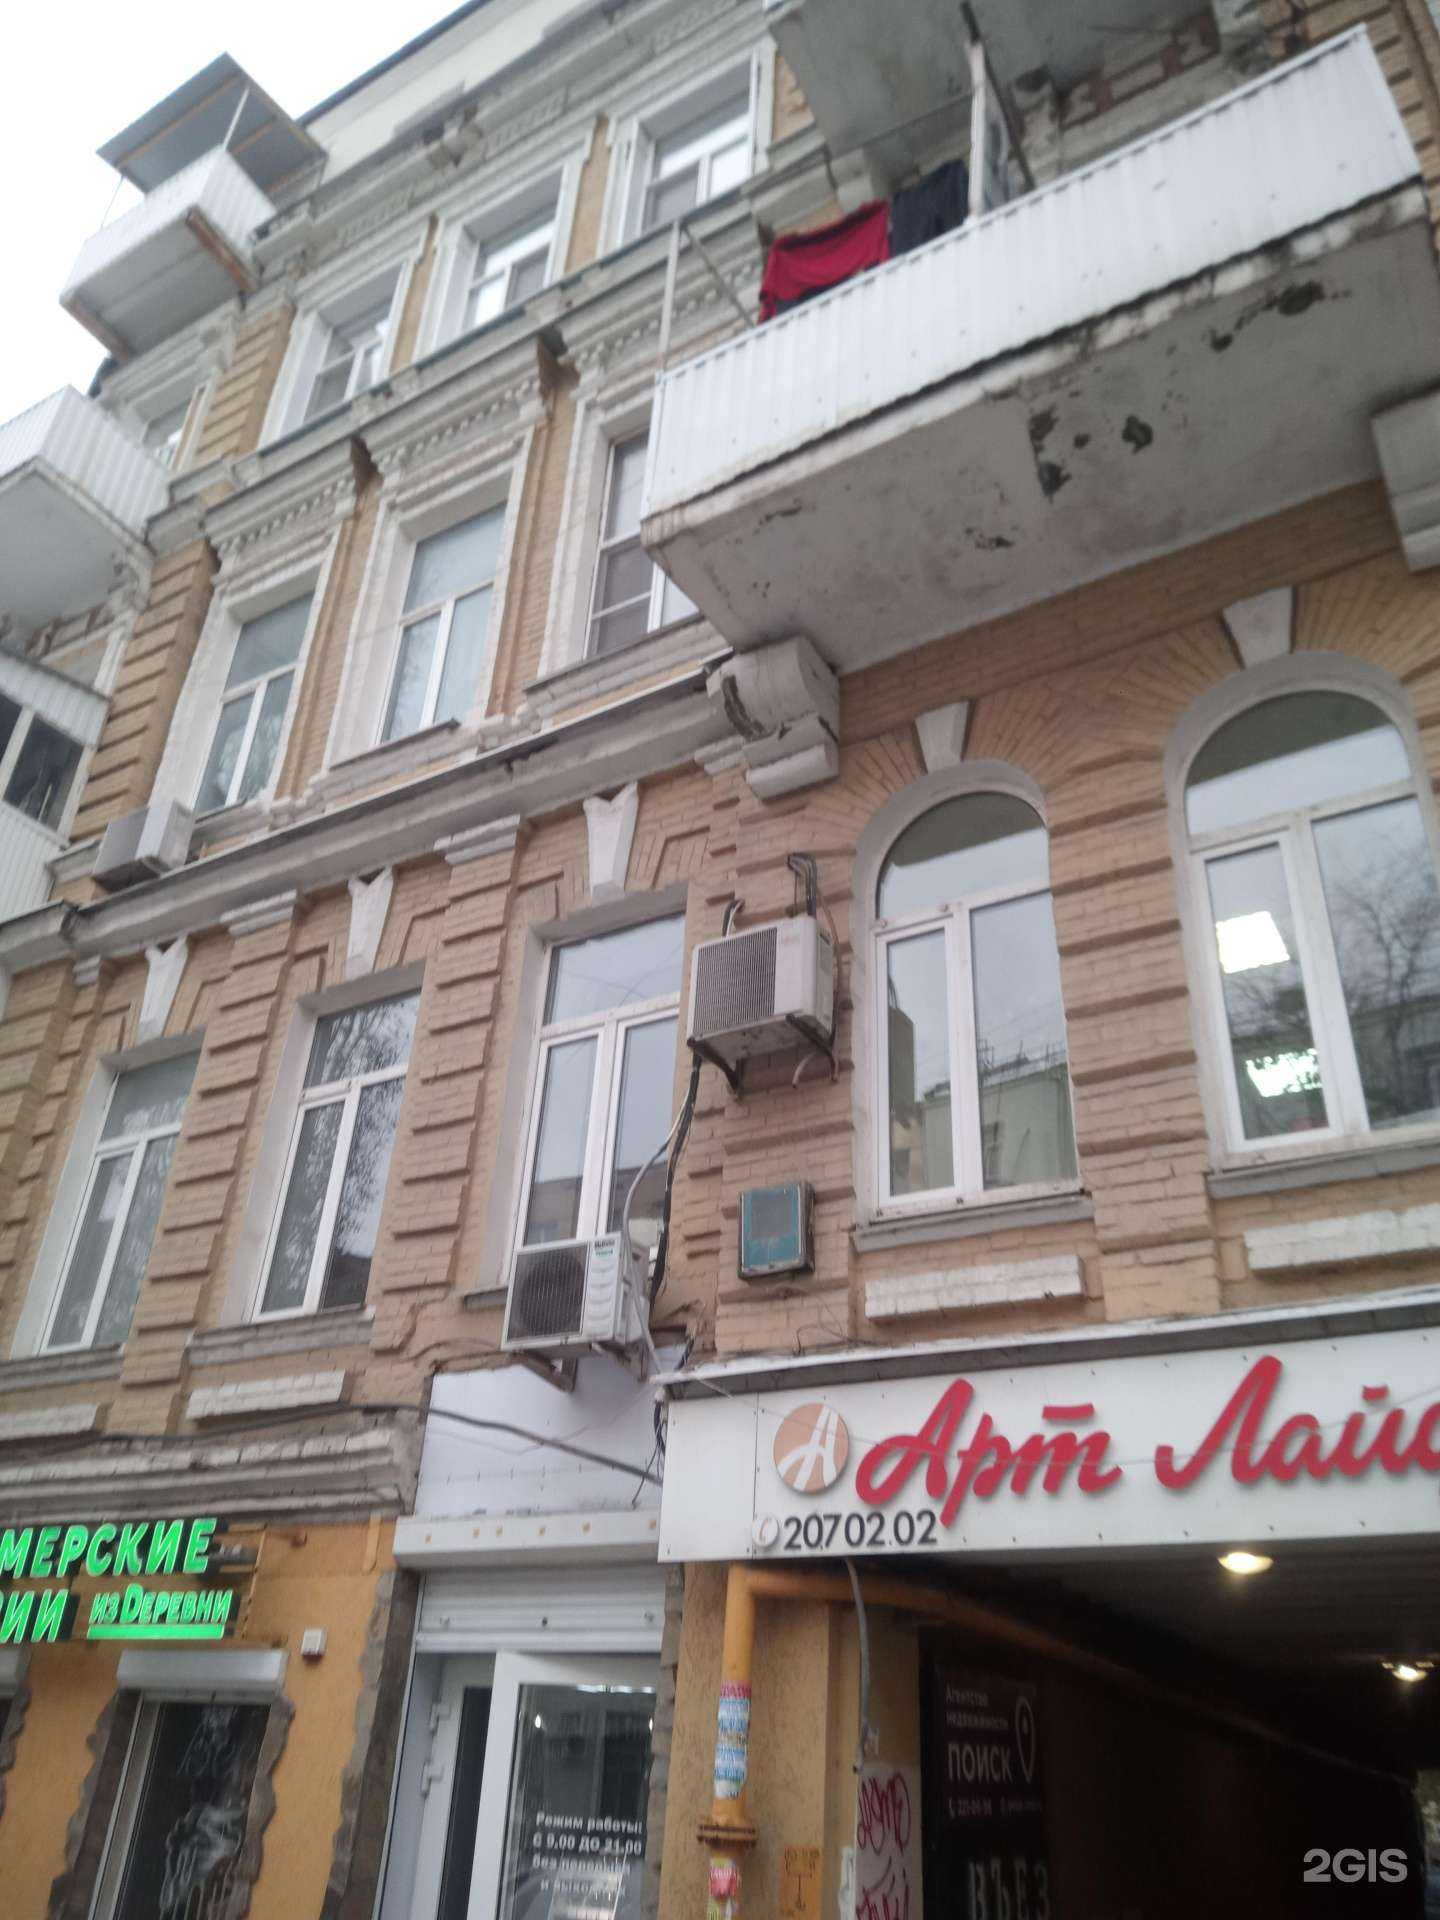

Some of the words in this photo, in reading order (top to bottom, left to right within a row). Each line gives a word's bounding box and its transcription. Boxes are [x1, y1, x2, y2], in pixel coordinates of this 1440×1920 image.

[855, 1379, 1123, 1528] Арт
[0, 1518, 218, 1579] МЕРСКИЕ
[0, 1588, 69, 1644] ИИ
[948, 1741, 1013, 1783] ПОИСК
[536, 1811, 583, 1830] Режим
